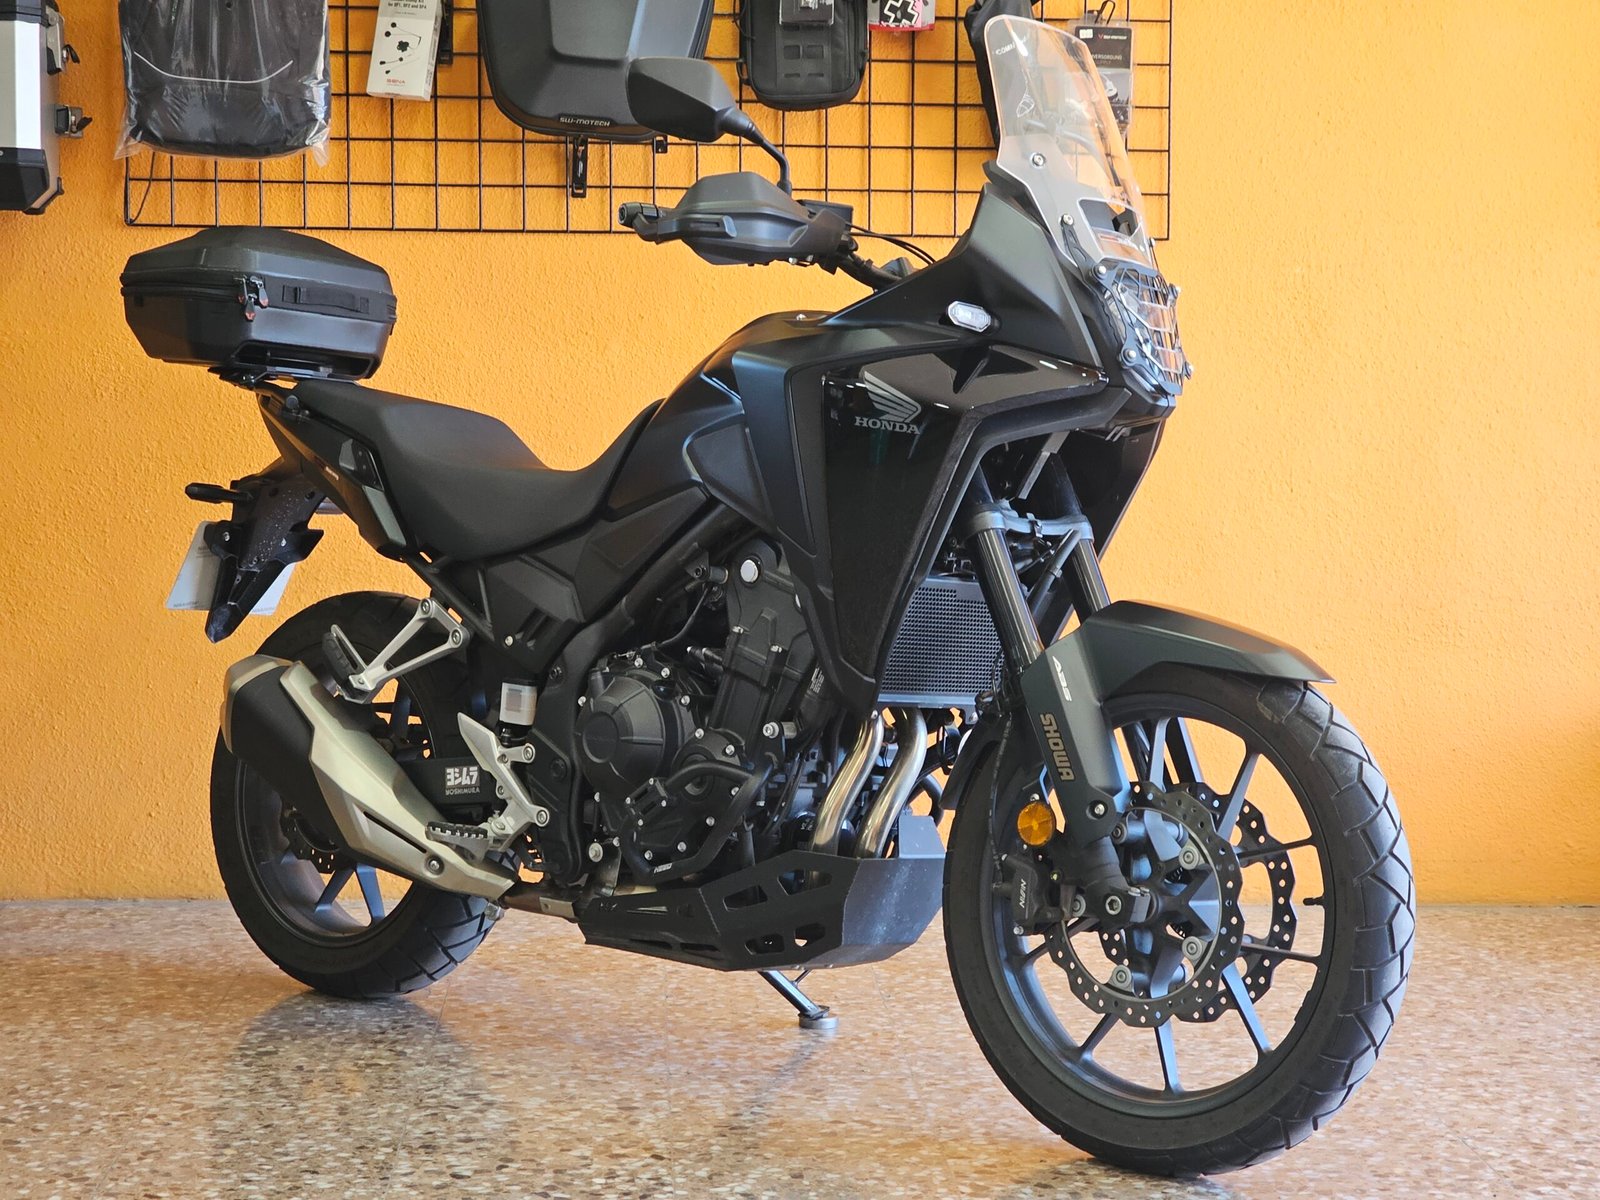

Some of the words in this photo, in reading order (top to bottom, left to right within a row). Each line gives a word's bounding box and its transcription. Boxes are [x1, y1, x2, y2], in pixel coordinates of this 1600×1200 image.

[560, 117, 611, 127] SW-MOTECH
[854, 416, 921, 435] HONDA
[1052, 655, 1073, 702] ABS
[1040, 713, 1075, 781] SHOWA
[446, 766, 478, 786] ヨシムラ
[445, 786, 480, 796] YOSHIMURA
